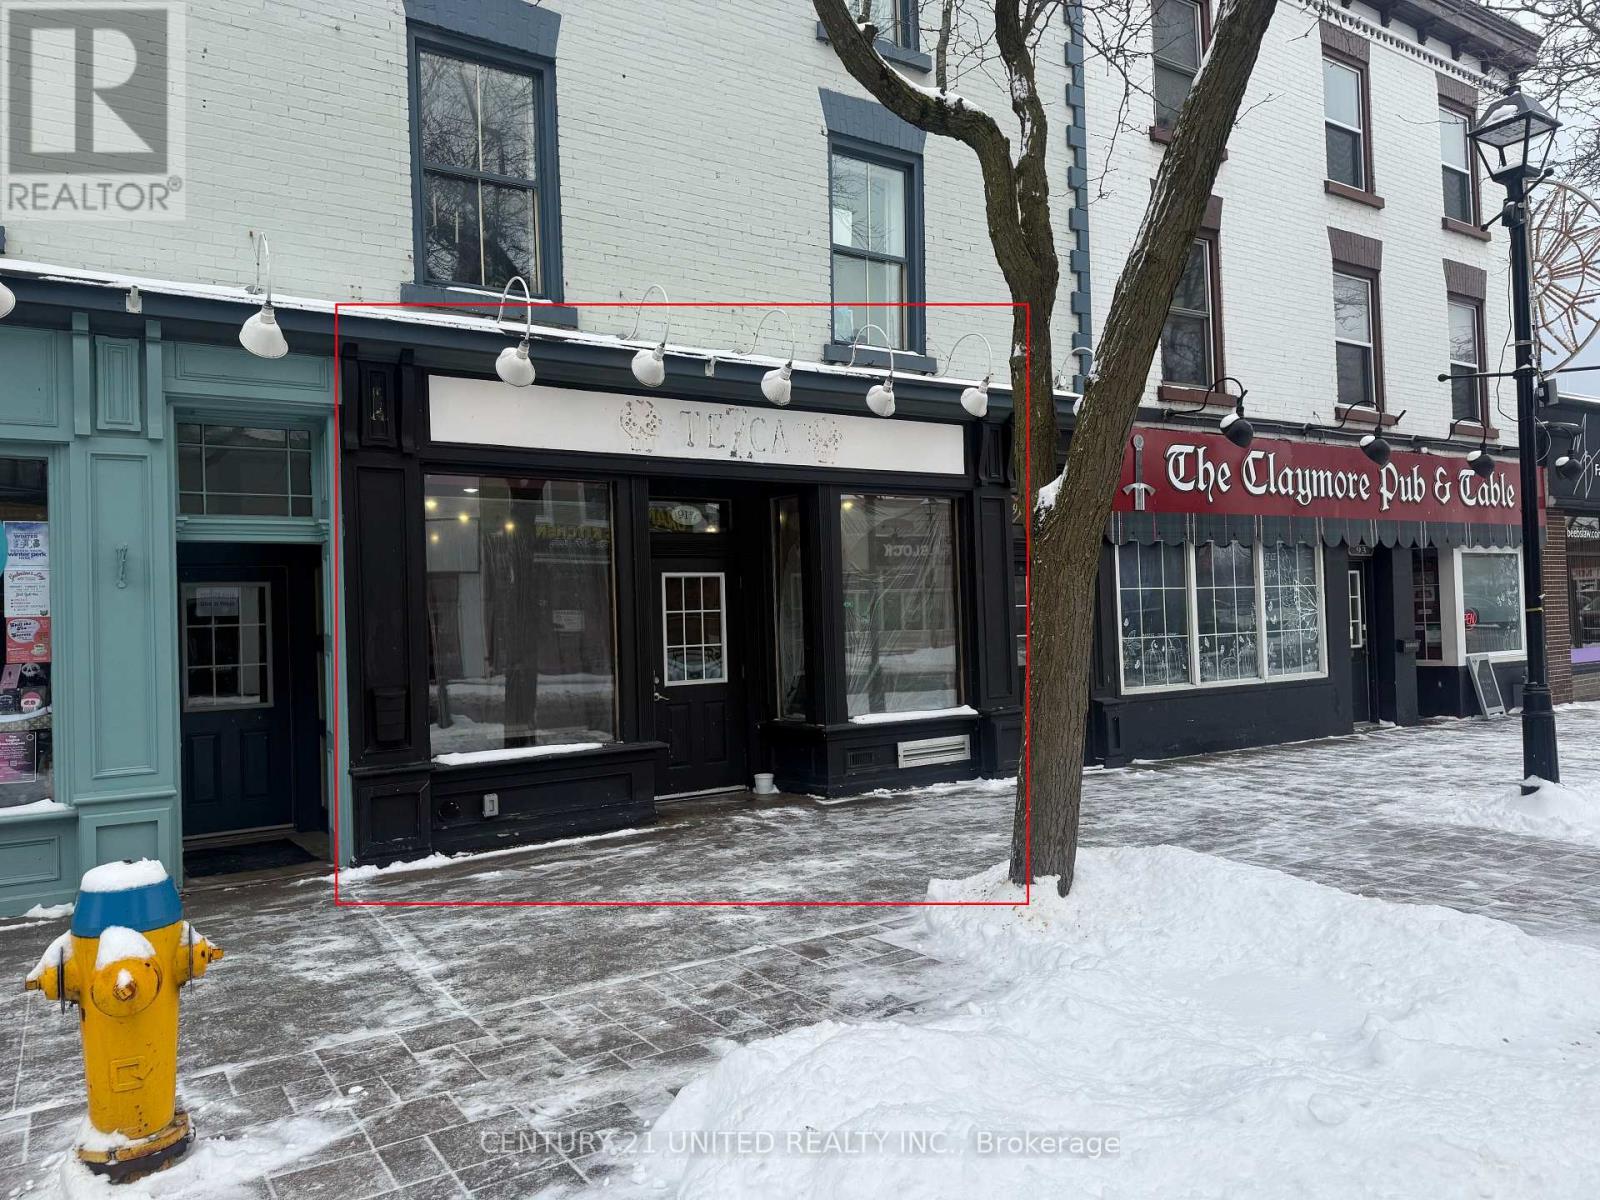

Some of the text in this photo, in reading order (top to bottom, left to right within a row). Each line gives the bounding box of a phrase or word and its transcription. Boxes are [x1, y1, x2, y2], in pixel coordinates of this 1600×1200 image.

[1165, 444, 1515, 512] The Claymore Pub & Table
